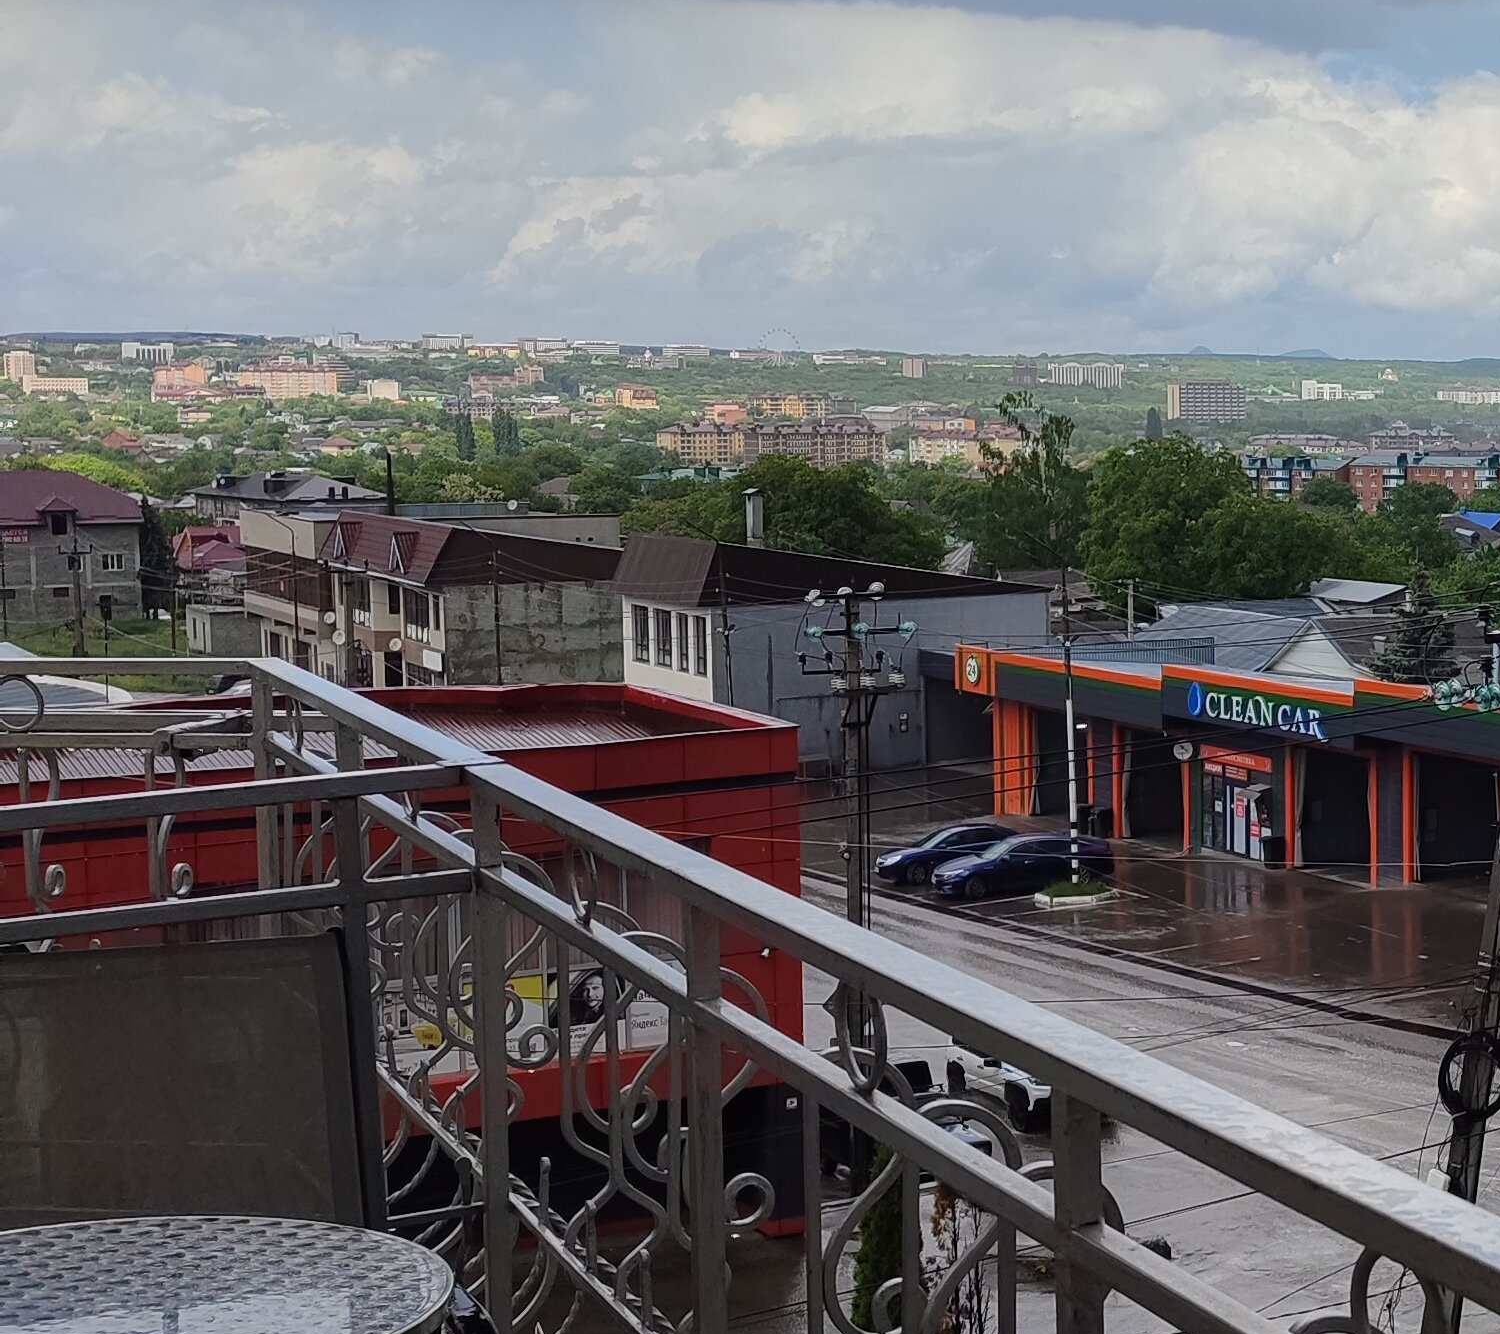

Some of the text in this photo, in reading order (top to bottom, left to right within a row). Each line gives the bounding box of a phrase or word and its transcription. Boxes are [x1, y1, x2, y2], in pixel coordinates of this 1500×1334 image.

[1205, 692, 1328, 743] CLEAN CAR
[631, 1019, 659, 1030] Яндекс
